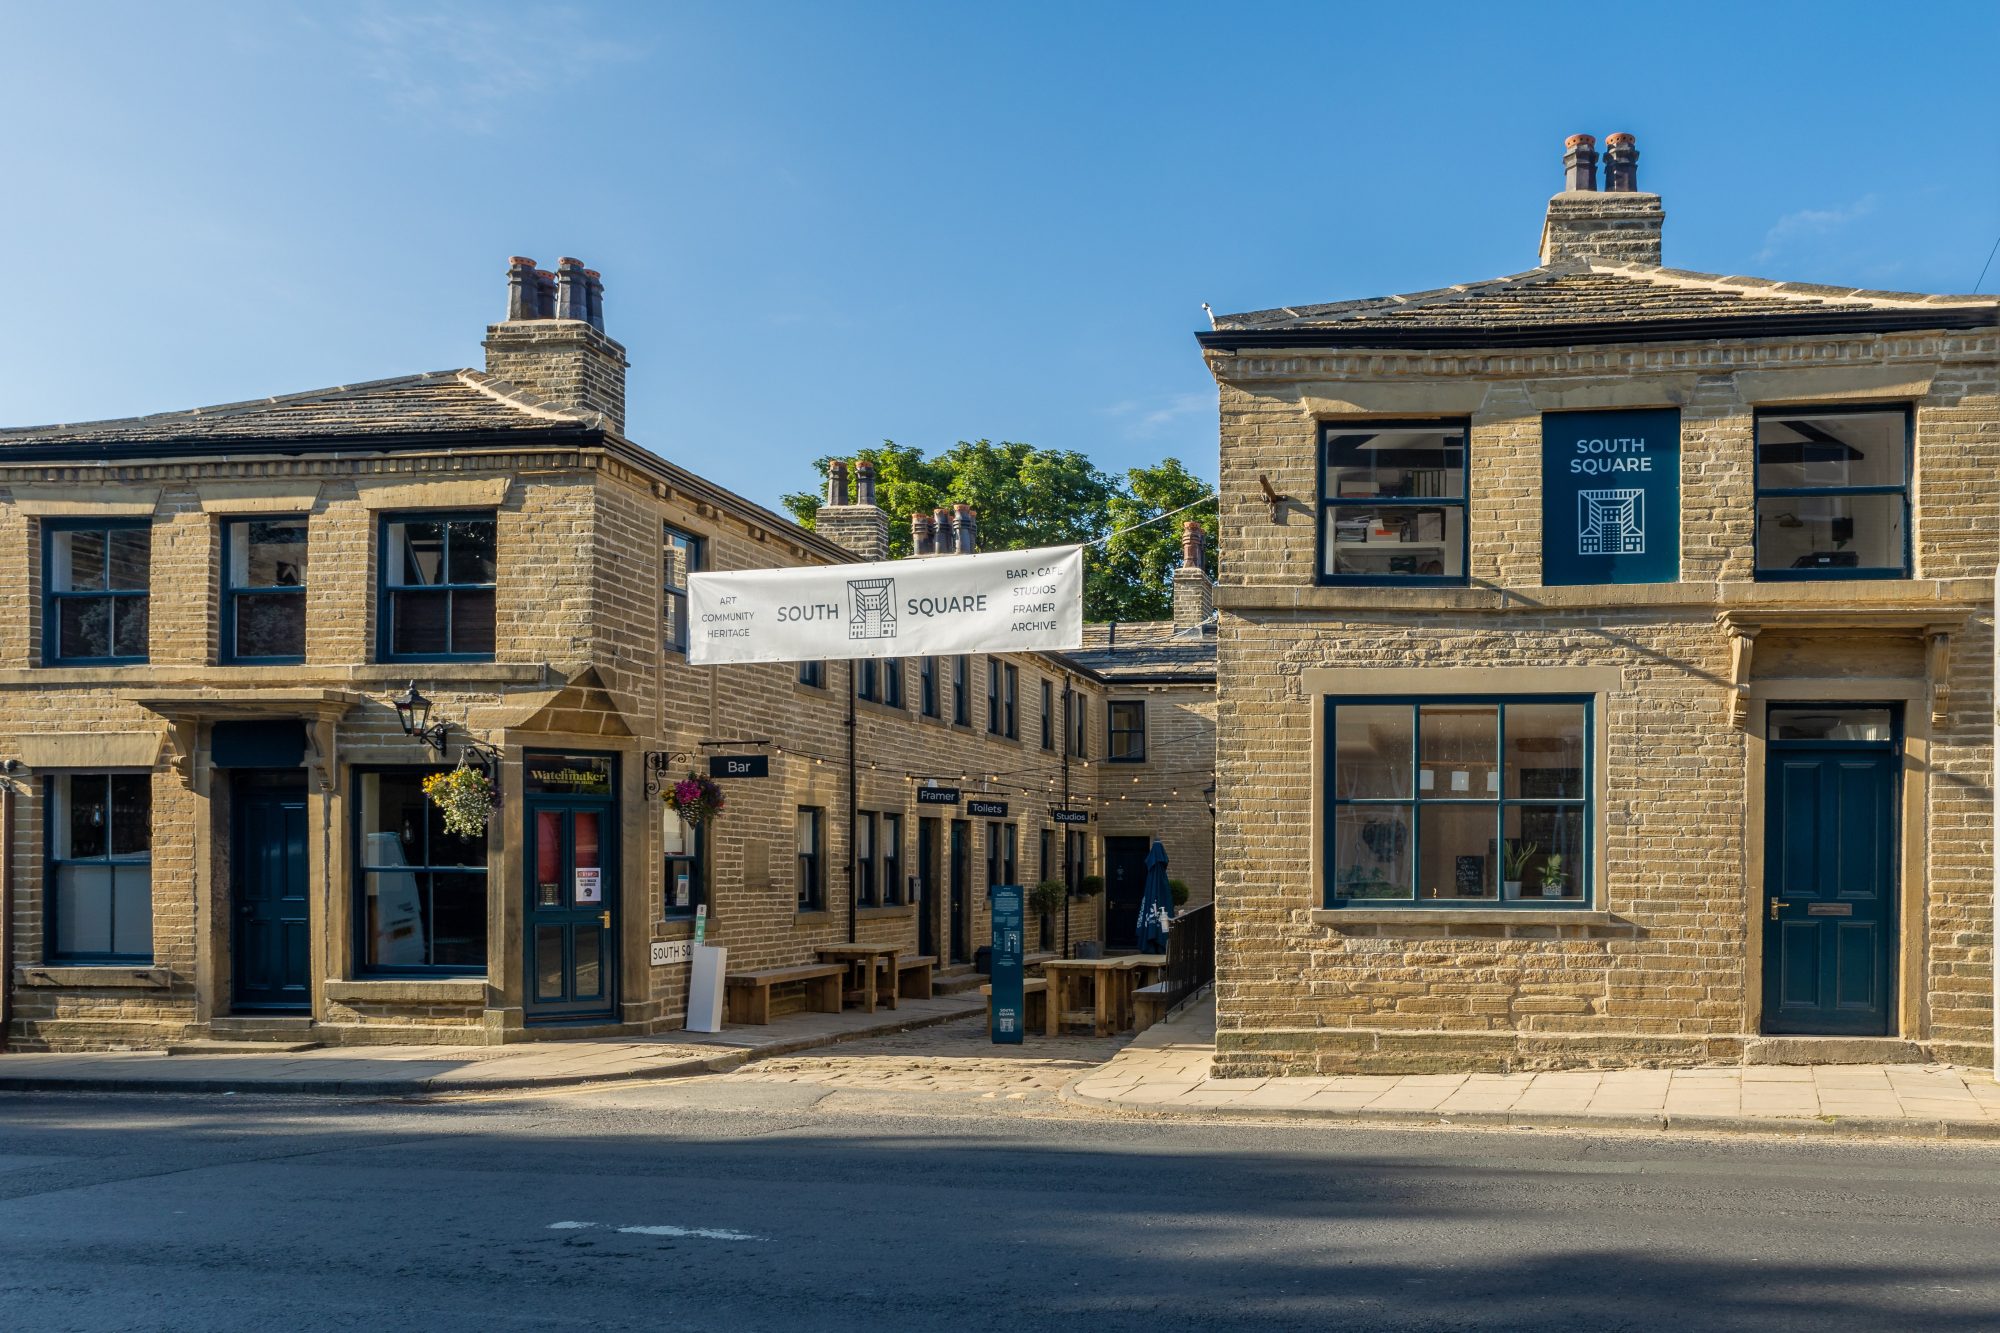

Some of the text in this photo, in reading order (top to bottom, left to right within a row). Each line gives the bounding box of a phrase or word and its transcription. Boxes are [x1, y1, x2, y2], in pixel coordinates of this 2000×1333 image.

[1576, 438, 1645, 454] SOUTH
[1570, 457, 1652, 475] SQUARE
[1006, 569, 1028, 579] BAR
[1013, 585, 1057, 597] STUDIOS
[719, 596, 737, 605] ART
[777, 594, 987, 622] SOUTH SQUARE
[1013, 603, 1056, 614] FRAMER
[701, 611, 755, 623] COMMUNITY
[1011, 620, 1057, 632] ARCHIVE
[707, 628, 750, 638] HERITAGE
[728, 761, 751, 773] Bar
[531, 770, 606, 781] Watchmaker
[920, 790, 956, 801] Framer
[973, 803, 1002, 814] Toilets
[1056, 812, 1086, 821] Studios
[653, 946, 680, 960] SOUTH
